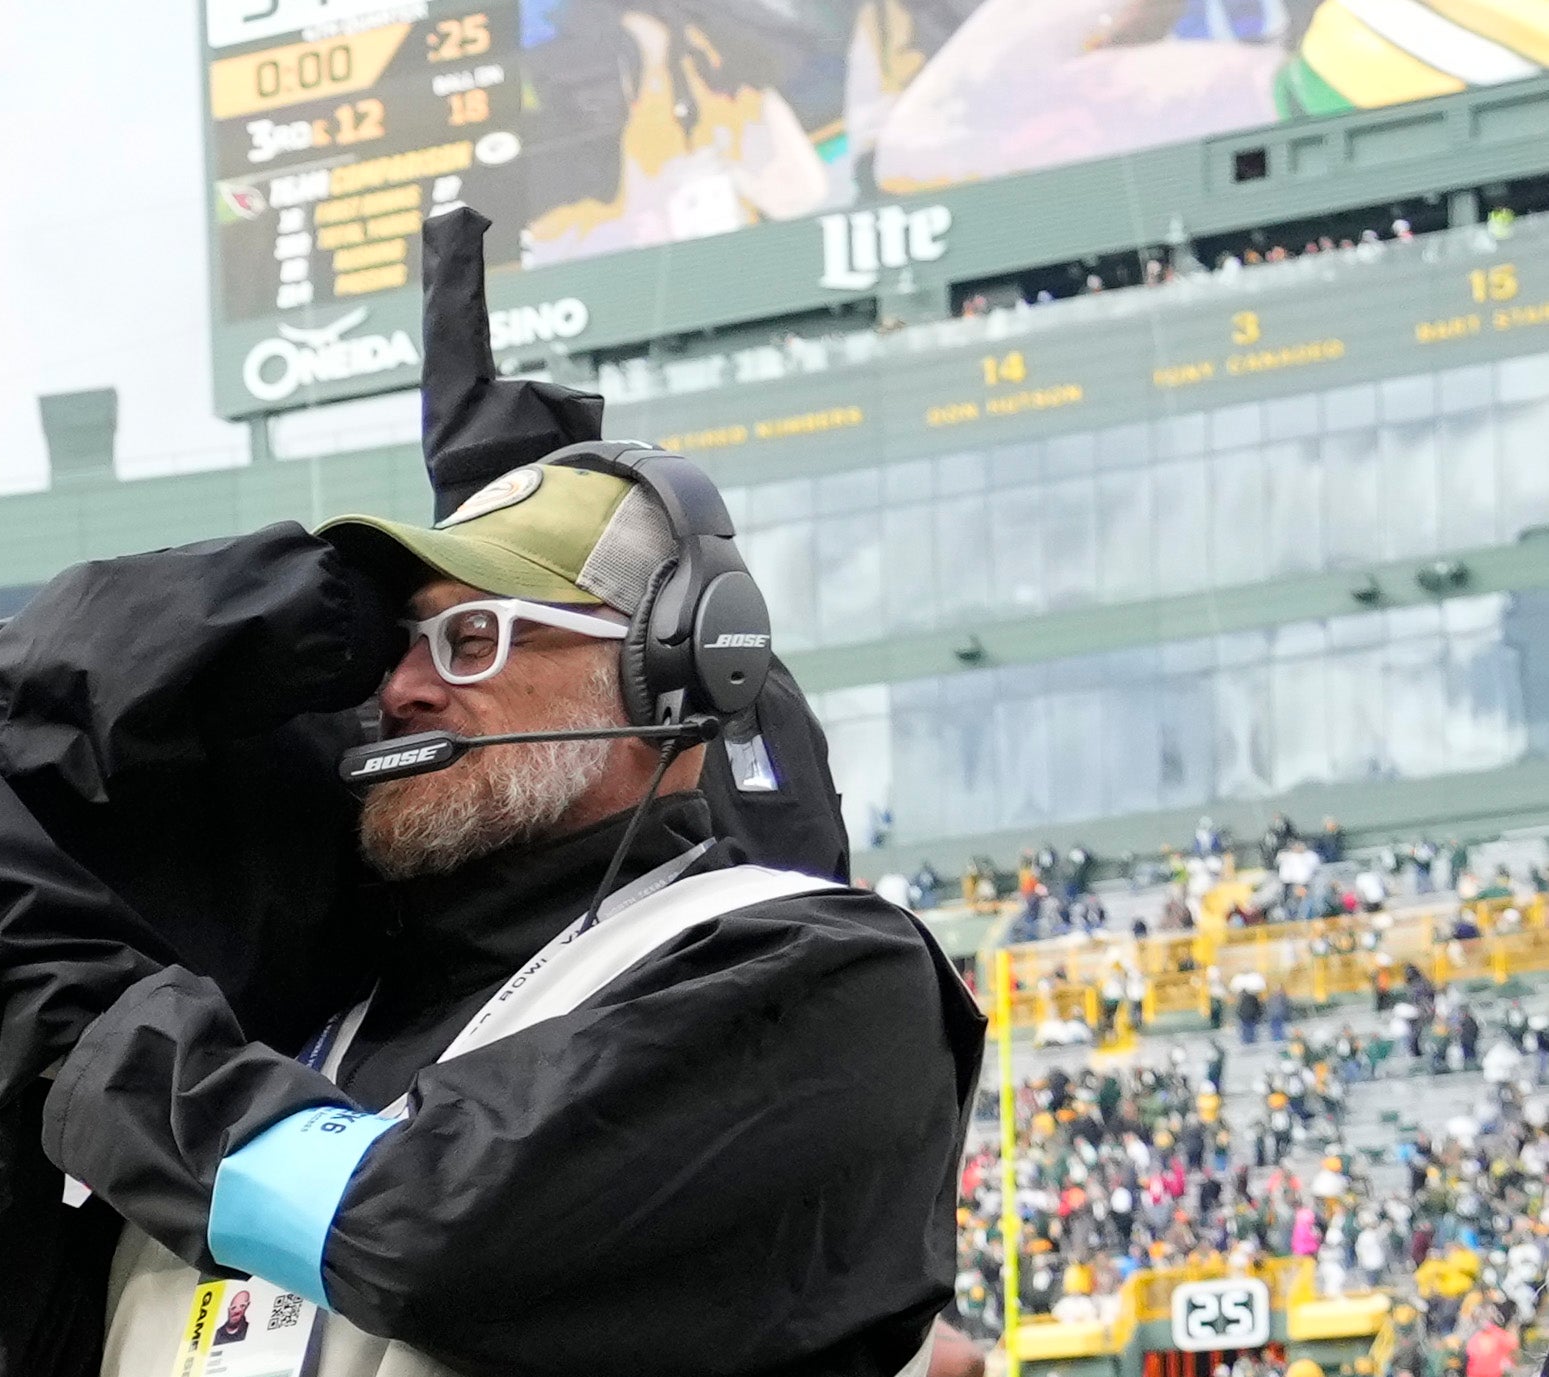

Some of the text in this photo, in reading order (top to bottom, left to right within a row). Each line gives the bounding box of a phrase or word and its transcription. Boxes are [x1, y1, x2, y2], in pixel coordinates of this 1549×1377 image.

[256, 44, 353, 98] 0:00
[333, 97, 386, 146] 12
[818, 204, 952, 291] Lite
[1468, 262, 1520, 304] 15
[242, 297, 589, 401] ONEIDA SINO
[1231, 311, 1261, 346] 3
[980, 350, 1027, 386] 14
[704, 633, 771, 649] BOSE
[350, 741, 448, 777] BOSE
[188, 1290, 213, 1353] GAME
[1188, 1290, 1253, 1338] 25
